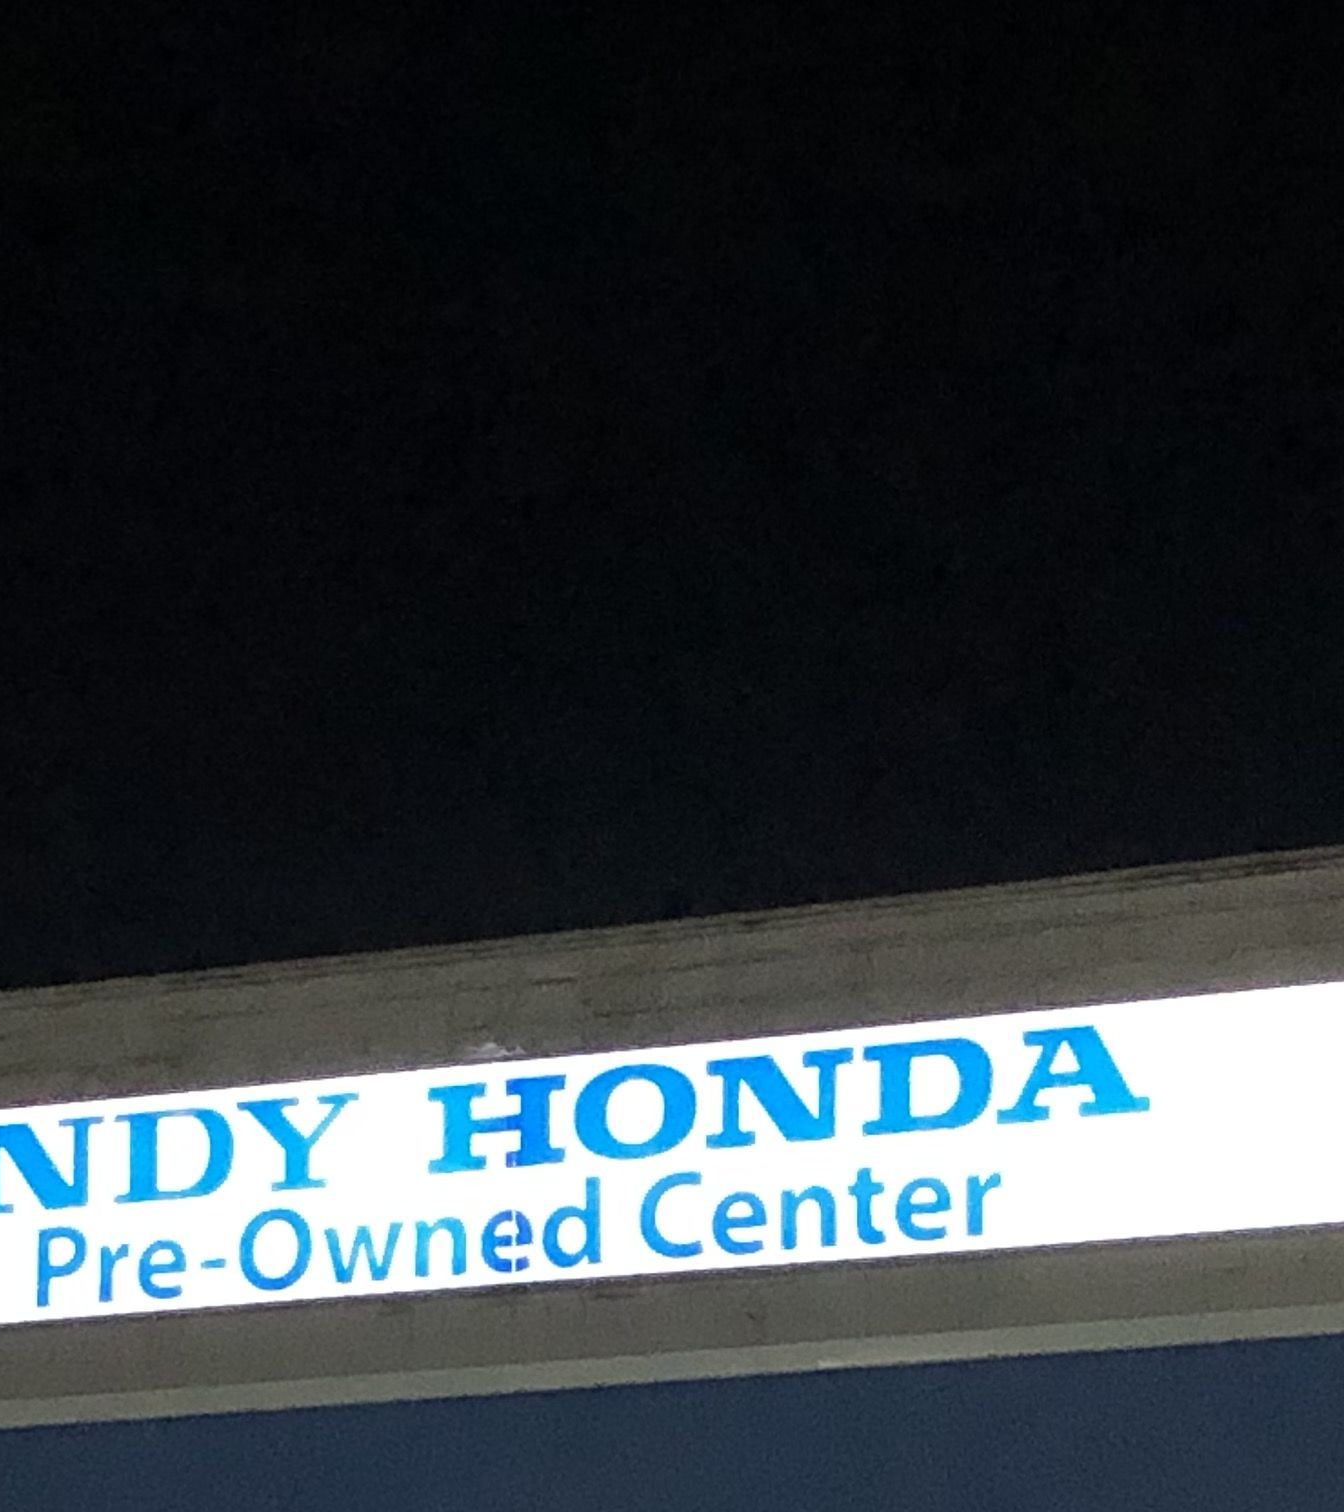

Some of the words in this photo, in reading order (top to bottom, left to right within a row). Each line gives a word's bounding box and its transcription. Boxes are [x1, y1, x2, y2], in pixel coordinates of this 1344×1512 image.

[428, 1024, 1151, 1174] HONDA
[36, 1175, 603, 1307] Pre-Owned
[639, 1167, 1003, 1257] Center
